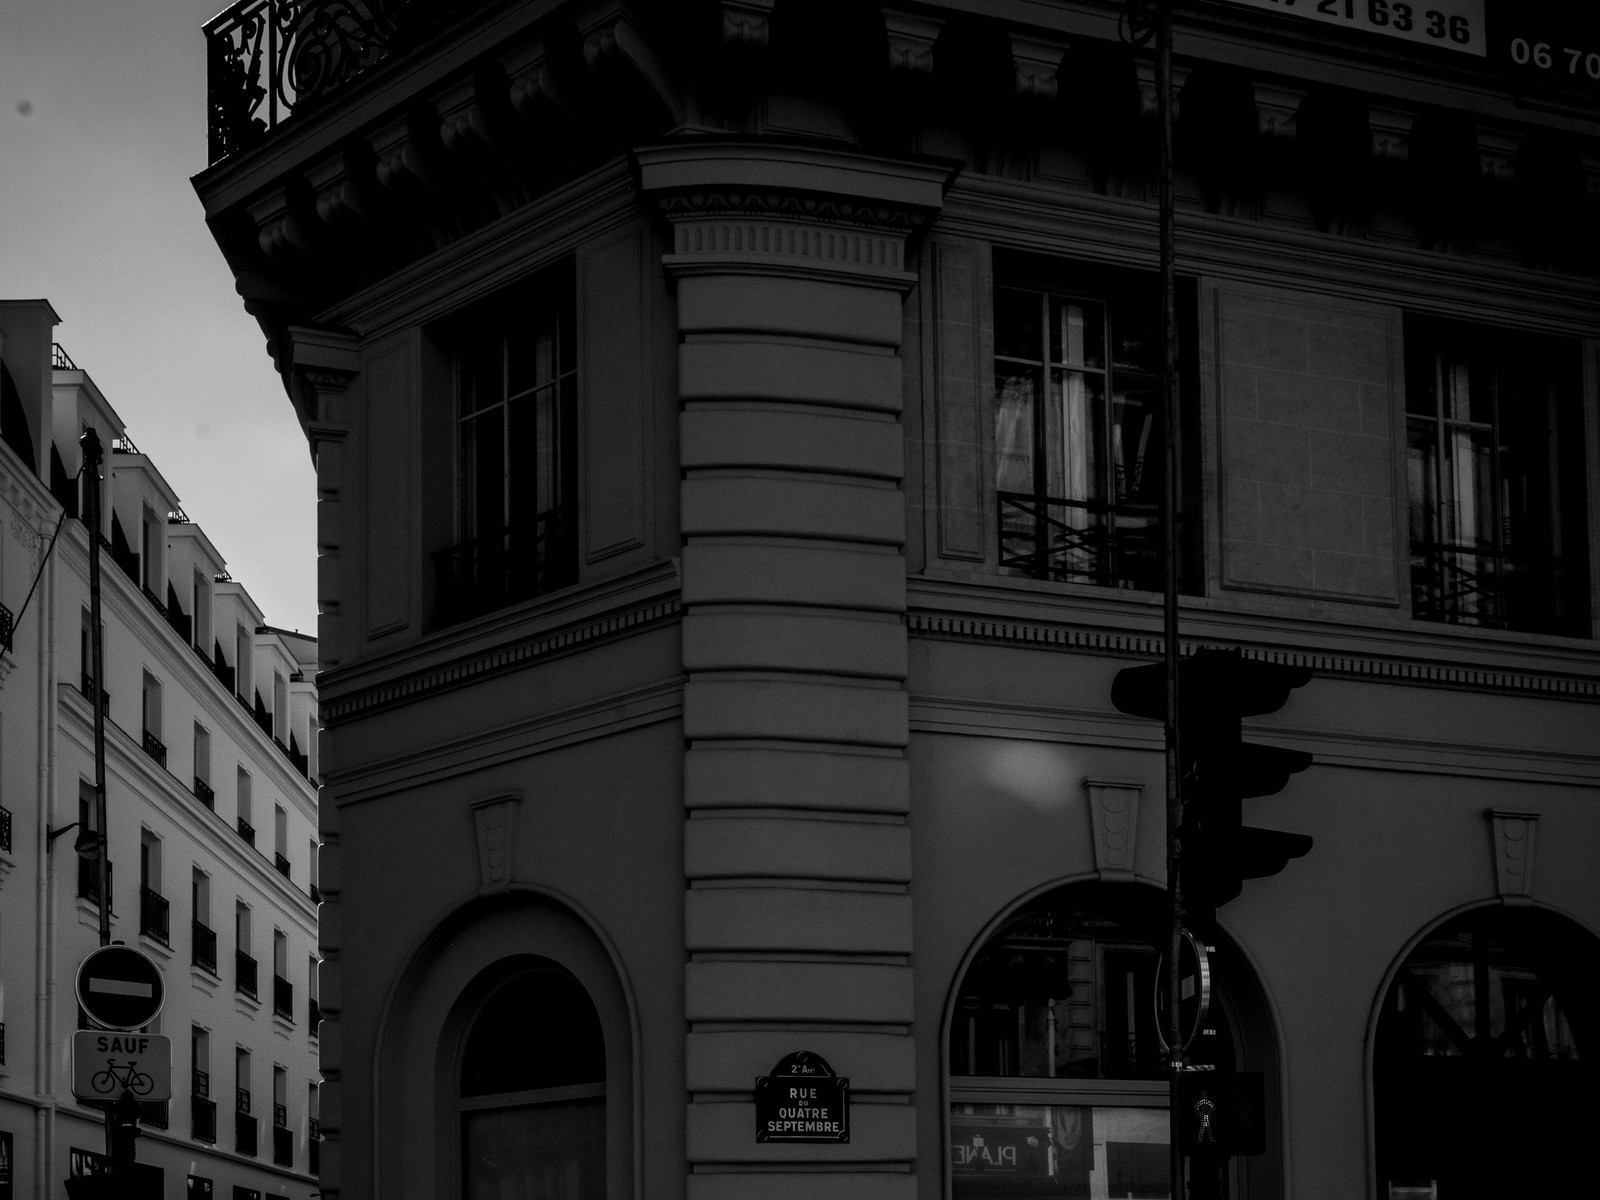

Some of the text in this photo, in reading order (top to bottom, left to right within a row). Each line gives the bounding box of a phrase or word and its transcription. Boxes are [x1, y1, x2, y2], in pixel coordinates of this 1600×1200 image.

[1368, 0, 1413, 31] 63
[1425, 10, 1470, 44] 36
[1510, 37, 1600, 79] 06 70
[97, 1036, 149, 1054] SAUF
[789, 1088, 817, 1099] RUE
[779, 1107, 829, 1119] QUATRE
[767, 1120, 840, 1132] SEPTEMBRE
